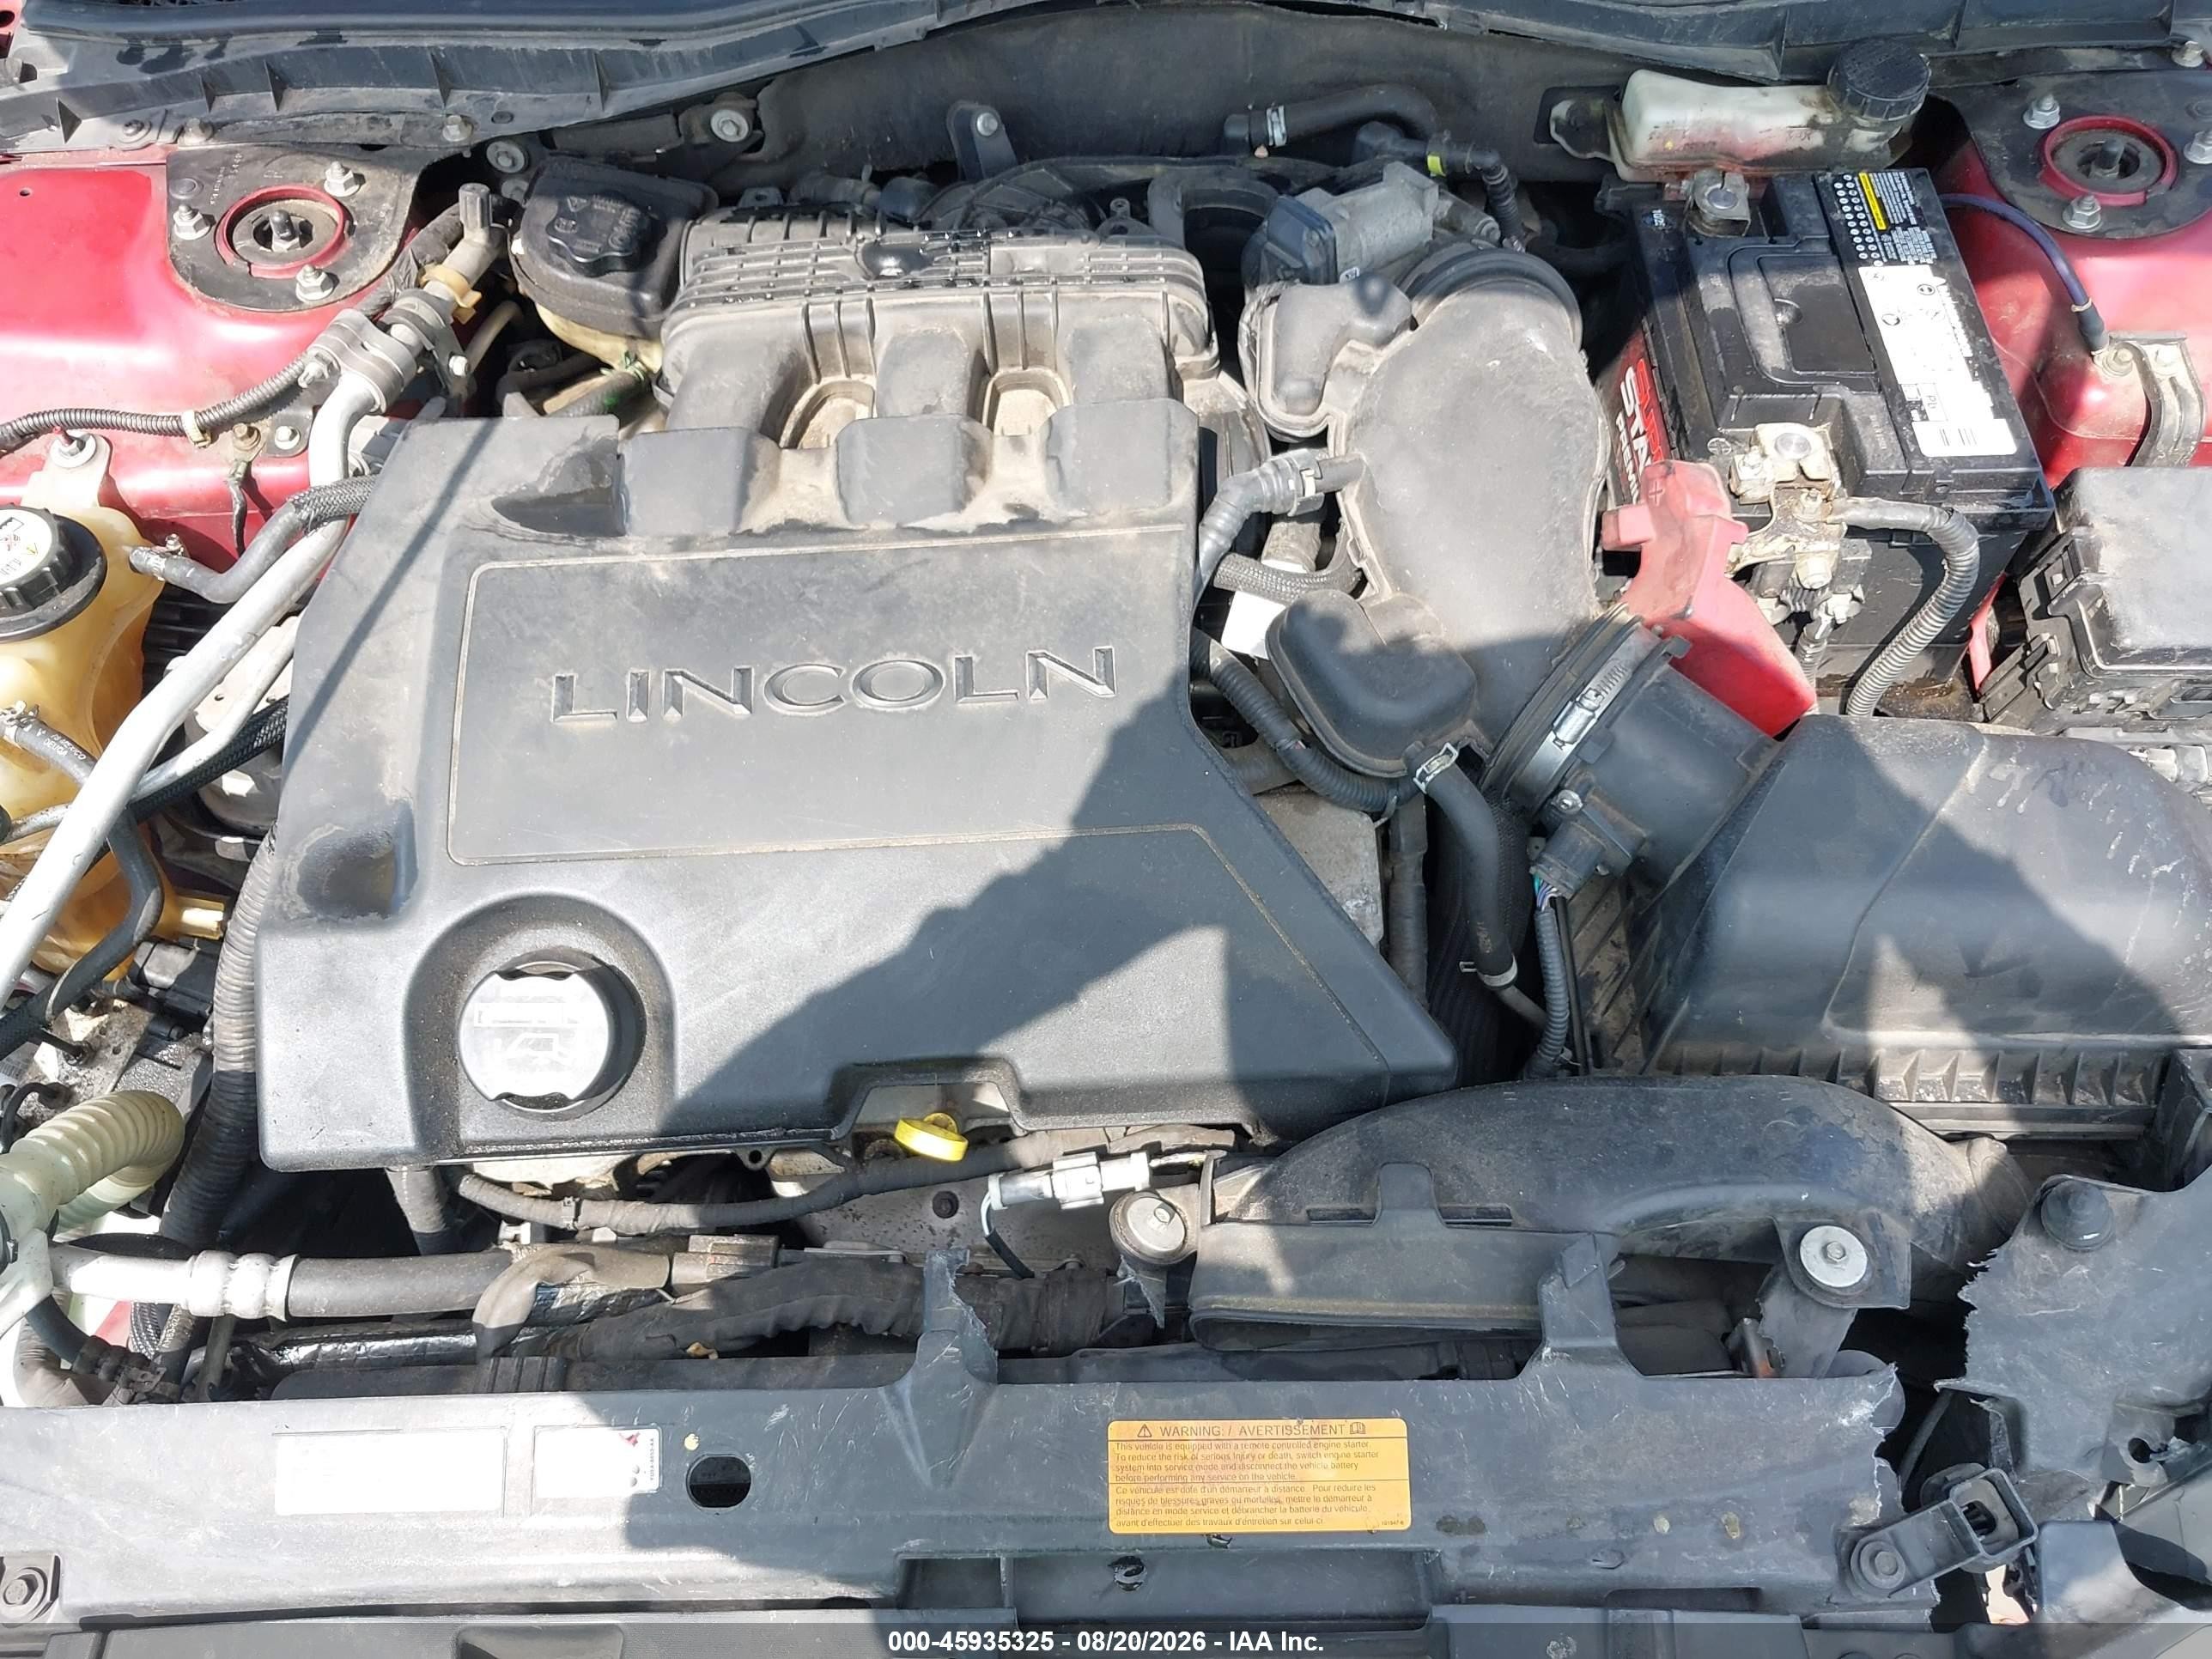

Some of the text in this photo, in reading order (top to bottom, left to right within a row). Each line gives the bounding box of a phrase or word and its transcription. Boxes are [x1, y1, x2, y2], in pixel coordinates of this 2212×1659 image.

[1620, 365, 1653, 477] STA
[551, 646, 1116, 723] LINCOLN
[1238, 1423, 1346, 1437] AVERTISSEMENT
[1116, 1442, 1133, 1451] This
[1134, 1442, 1164, 1451] vehicle
[1165, 1442, 1173, 1450] is
[1175, 1442, 1212, 1453] equipped
[1214, 1442, 1231, 1450] with
[1272, 1440, 1312, 1449] controlled
[1313, 1440, 1341, 1450] engine
[1116, 1453, 1127, 1462] To
[1127, 1453, 1157, 1462] reduce
[1158, 1452, 1172, 1461] the
[1174, 1452, 1188, 1461] risk
[1190, 1452, 1199, 1461] of
[1201, 1452, 1231, 1461] serious
[1233, 1451, 1255, 1462] injury
[1268, 1450, 1293, 1460] death,
[1297, 1450, 1322, 1460] switch
[1323, 1450, 1352, 1461] engine
[1353, 1450, 1379, 1459] starter
[1115, 1461, 1359, 1474] system into service mode and disconnect the vehicle battery
[1115, 1474, 1142, 1483] before
[1144, 1474, 1188, 1485] performing
[1190, 1475, 1205, 1484] any
[1207, 1473, 1237, 1481] service
[1251, 1472, 1265, 1481] the
[1116, 1486, 1127, 1494] Ce
[1130, 1485, 1163, 1494] véhicule
[1200, 1485, 1218, 1494] d'un
[1219, 1485, 1261, 1493] démarreur
[1312, 1484, 1332, 1492] Pour
[1334, 1484, 1363, 1492] réduire
[1364, 1483, 1376, 1492] les
[1115, 1497, 1146, 1507] risques
[1147, 1497, 1158, 1505] de
[1160, 1496, 1199, 1505] blessures
[1201, 1498, 1229, 1506] graves
[1285, 1495, 1312, 1504] mettre
[1322, 1494, 1364, 1503] démarreur
[1116, 1507, 1150, 1516] distance
[1164, 1507, 1188, 1516] mode
[1190, 1507, 1219, 1516] service
[1221, 1506, 1230, 1515] et
[1231, 1505, 1278, 1515] débrancher
[1279, 1505, 1288, 1514] la
[1289, 1504, 1321, 1513] batterie
[1322, 1504, 1333, 1513] du
[1140, 1517, 1183, 1527] d'effectuer
[1185, 1517, 1201, 1527] des
[1202, 1517, 1233, 1526] travaux
[1235, 1516, 1278, 1526] d'entretien
[1279, 1516, 1293, 1525] sur
